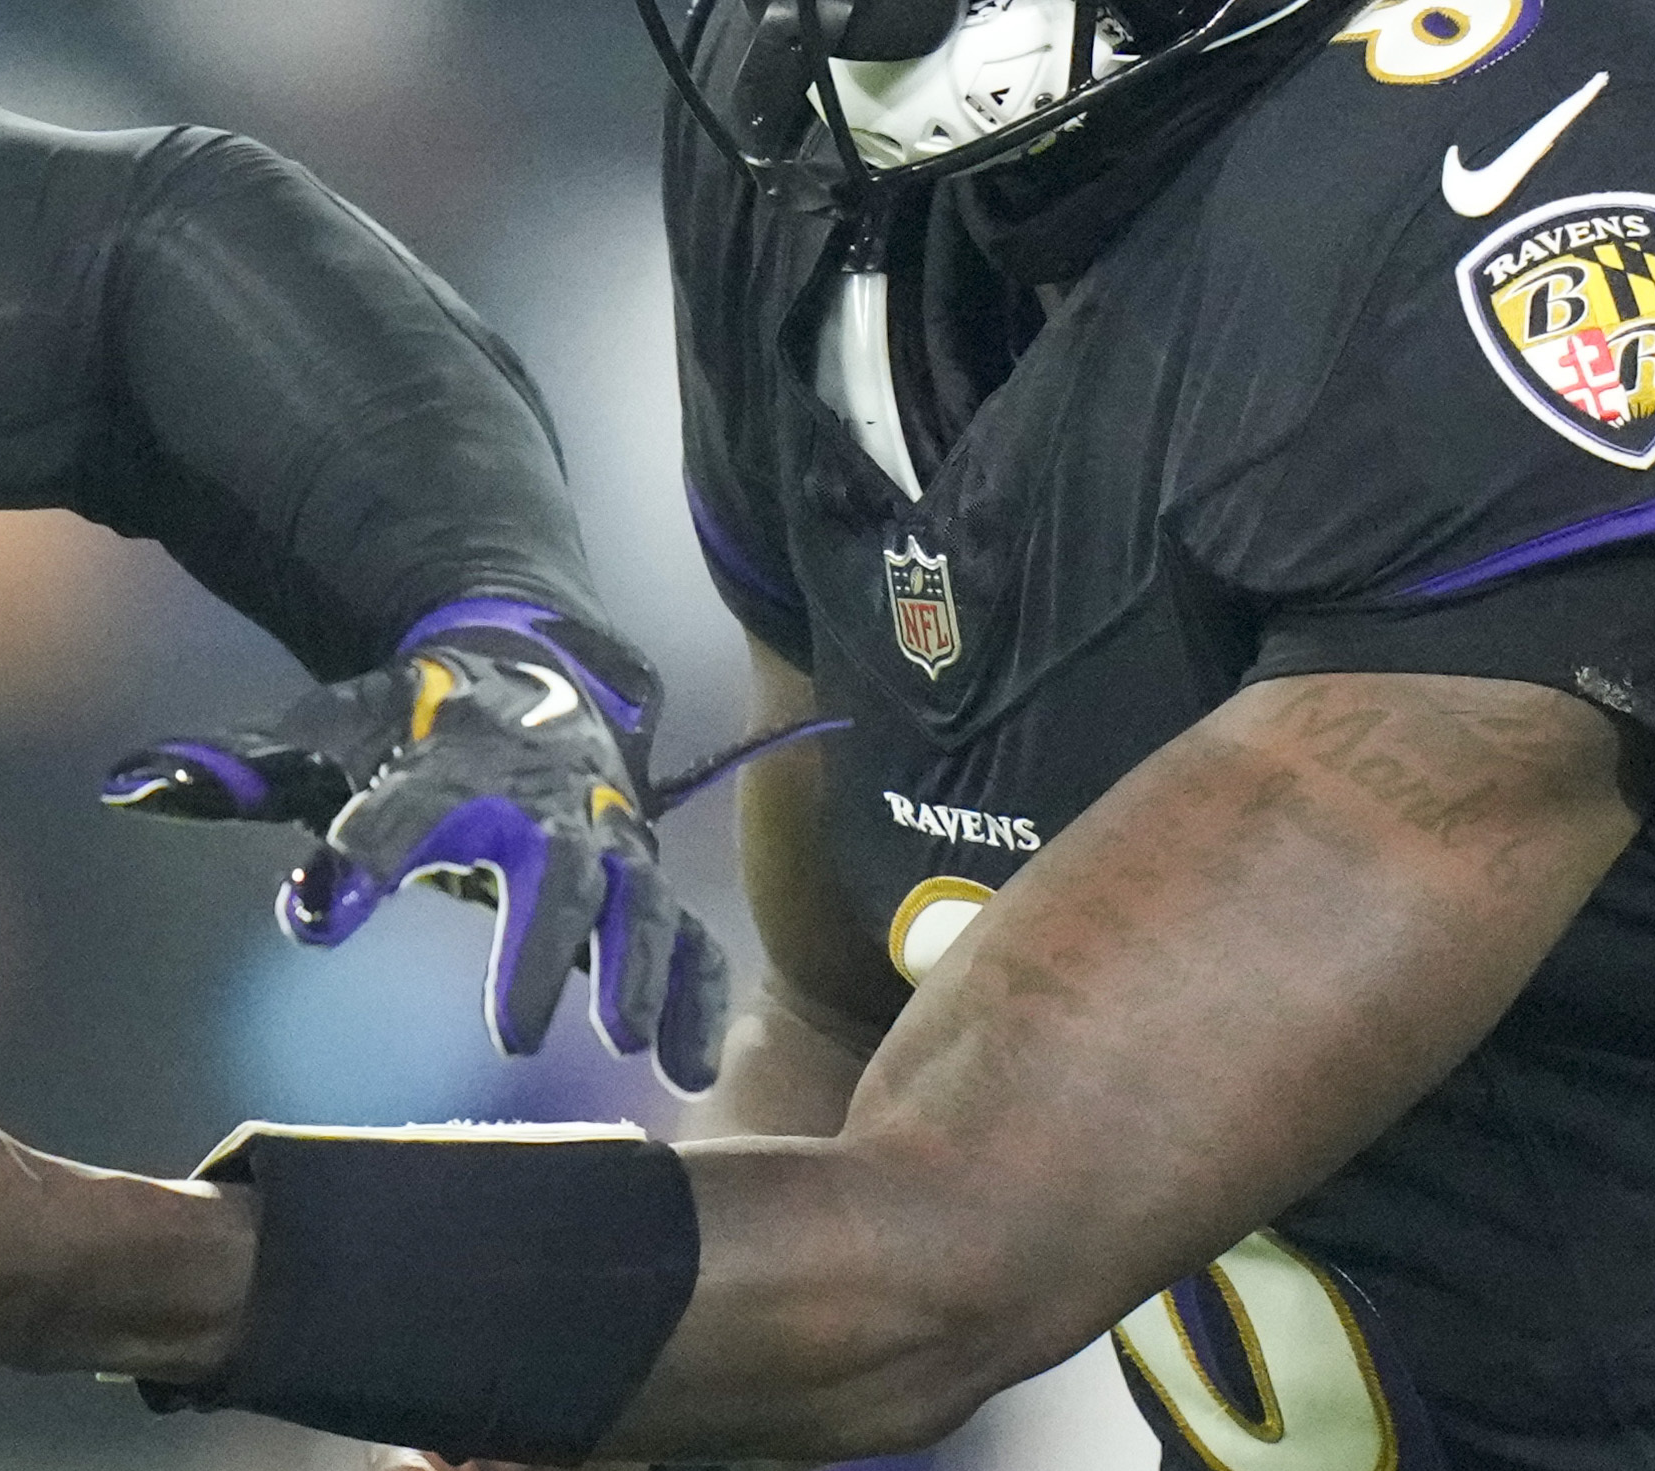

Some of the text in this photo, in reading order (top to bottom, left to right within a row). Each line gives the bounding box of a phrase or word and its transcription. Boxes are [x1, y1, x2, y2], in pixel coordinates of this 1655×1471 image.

[1483, 214, 1651, 287] RAVENS
[1498, 261, 1590, 344] B
[898, 599, 952, 656] NFL
[882, 790, 1042, 853] RAVENS
